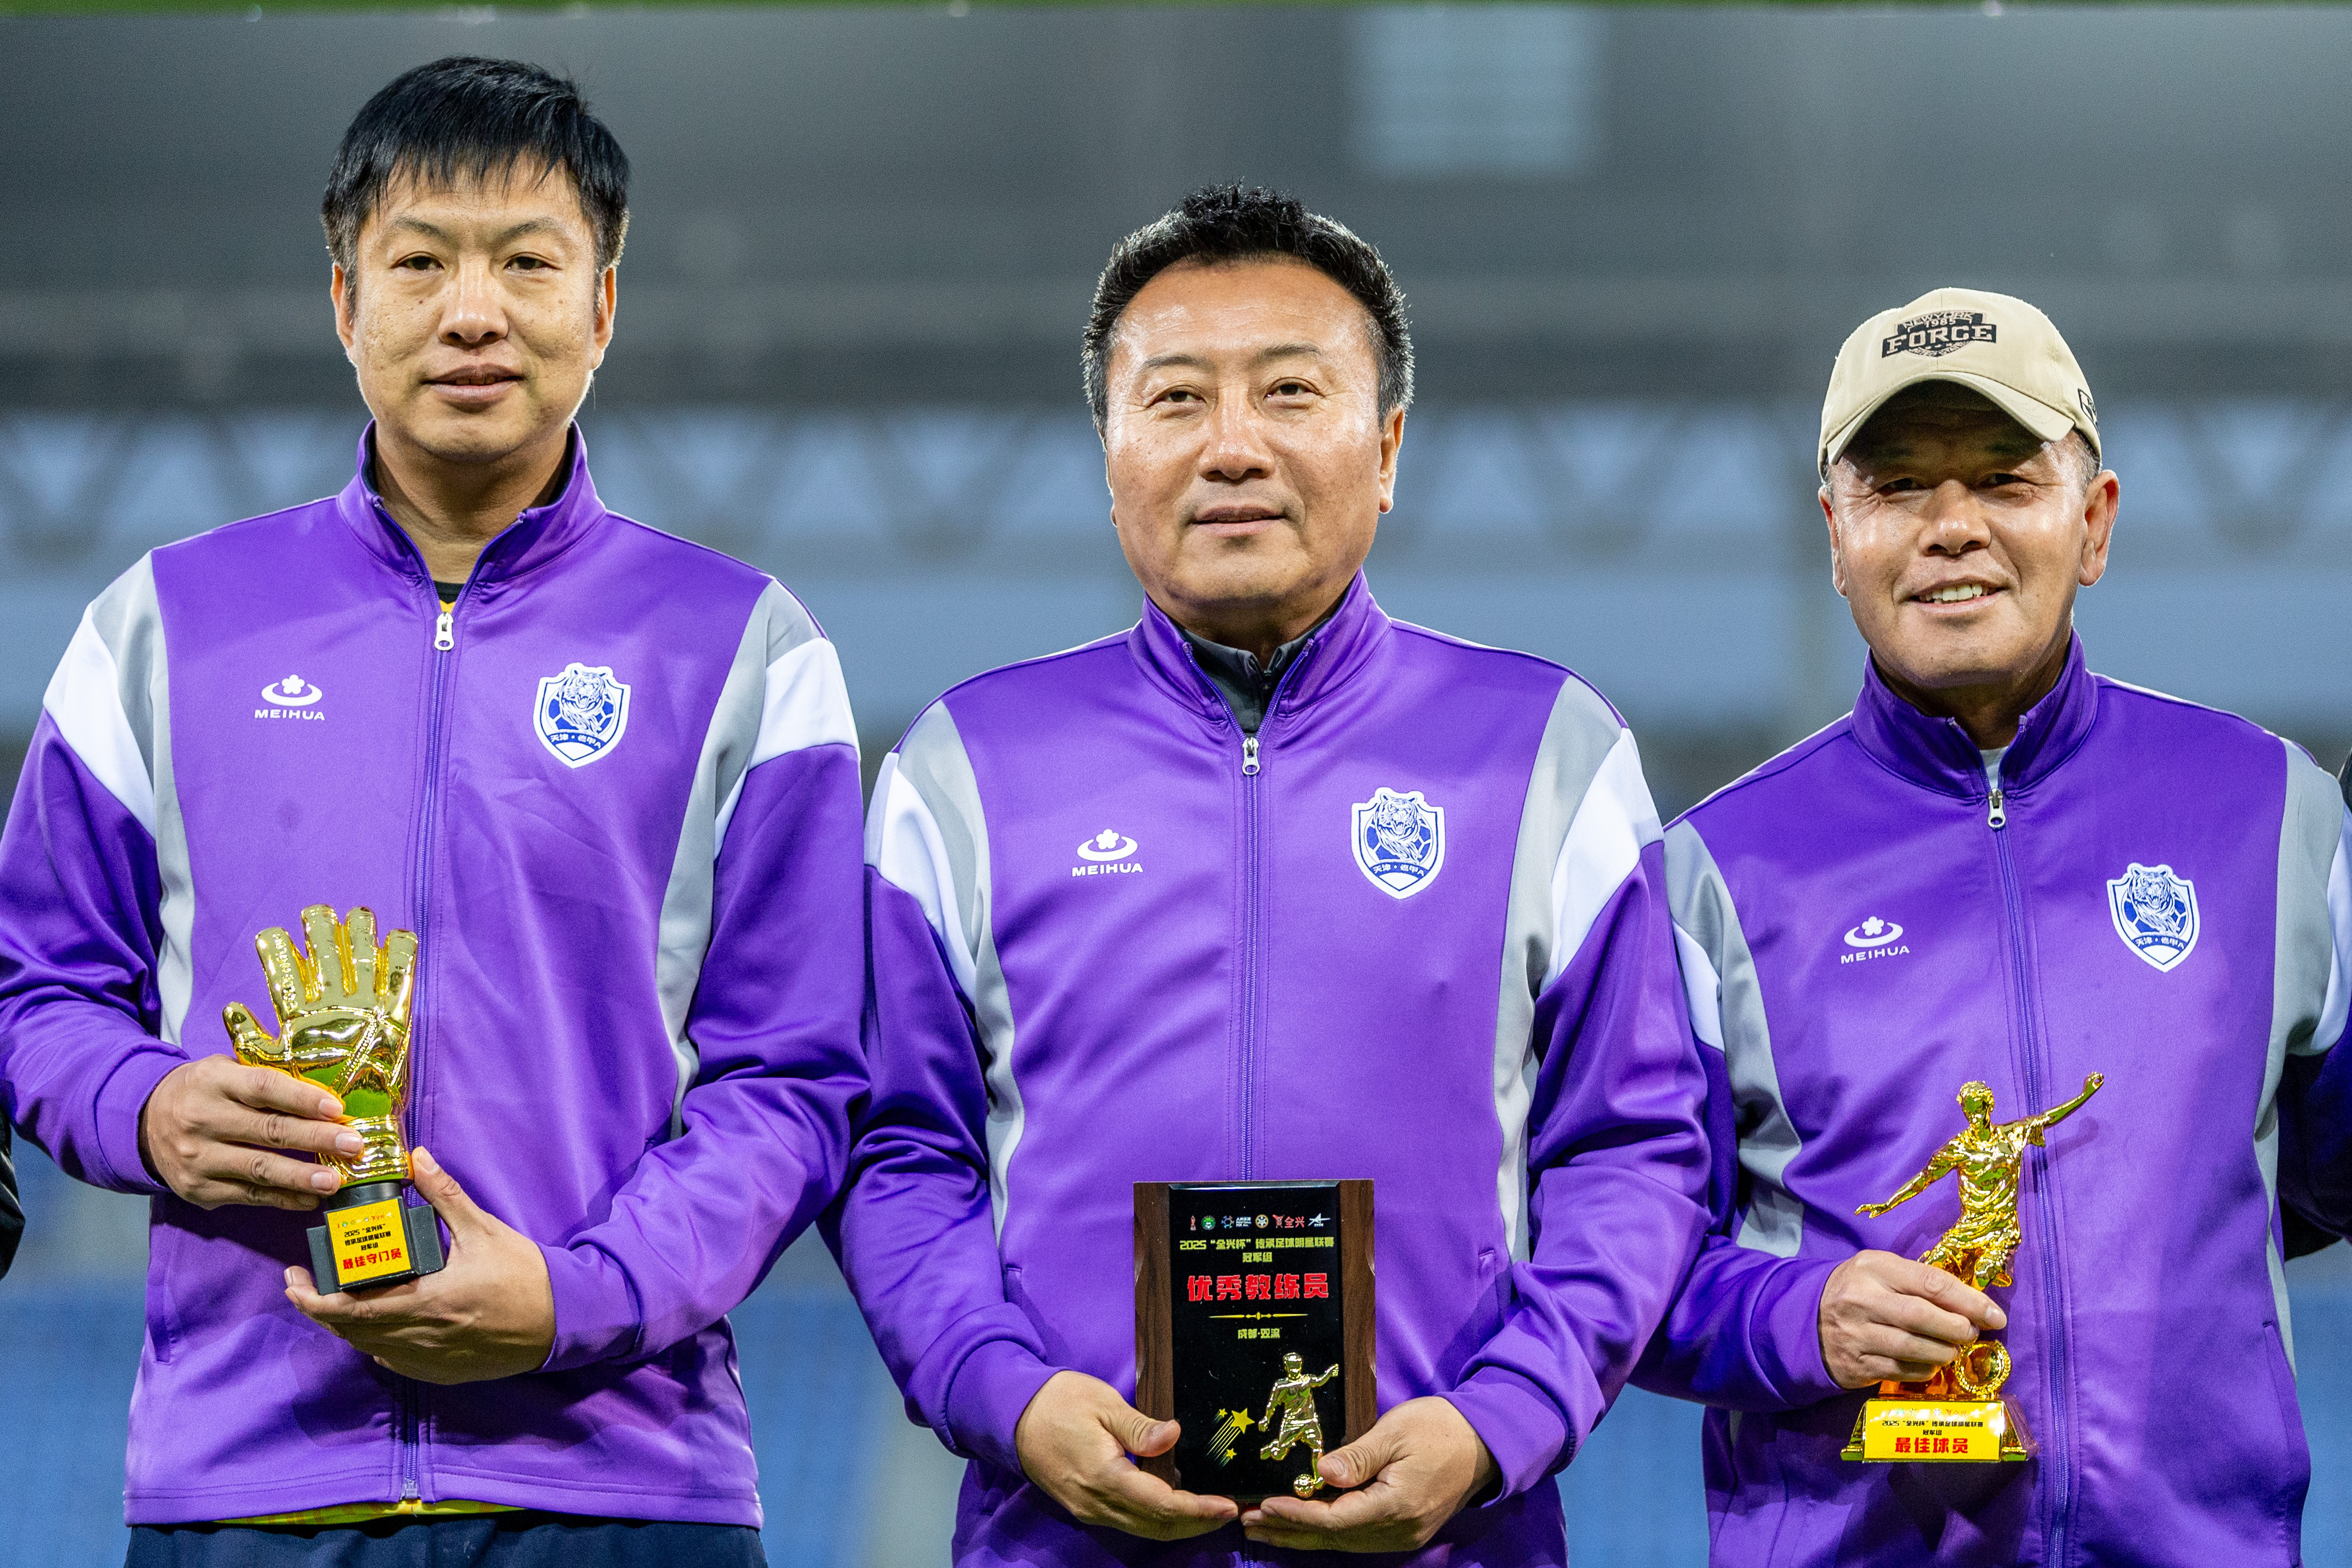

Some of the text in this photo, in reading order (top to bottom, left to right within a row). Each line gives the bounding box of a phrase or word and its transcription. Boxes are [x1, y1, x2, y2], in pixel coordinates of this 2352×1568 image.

[1925, 318, 1956, 328] 1985
[1886, 325, 1993, 354] FORCE
[254, 709, 325, 721] MEIHUA
[1072, 863, 1143, 877] MEIHUA
[1841, 945, 1910, 964] MEIHUA
[1284, 1216, 1305, 1228] 全兴
[343, 1248, 402, 1270] 最佳守门员
[1242, 1252, 1272, 1263] 冠军组
[1187, 1273, 1329, 1302] 优秀教练员
[1895, 1437, 1968, 1453] 最佳球员
